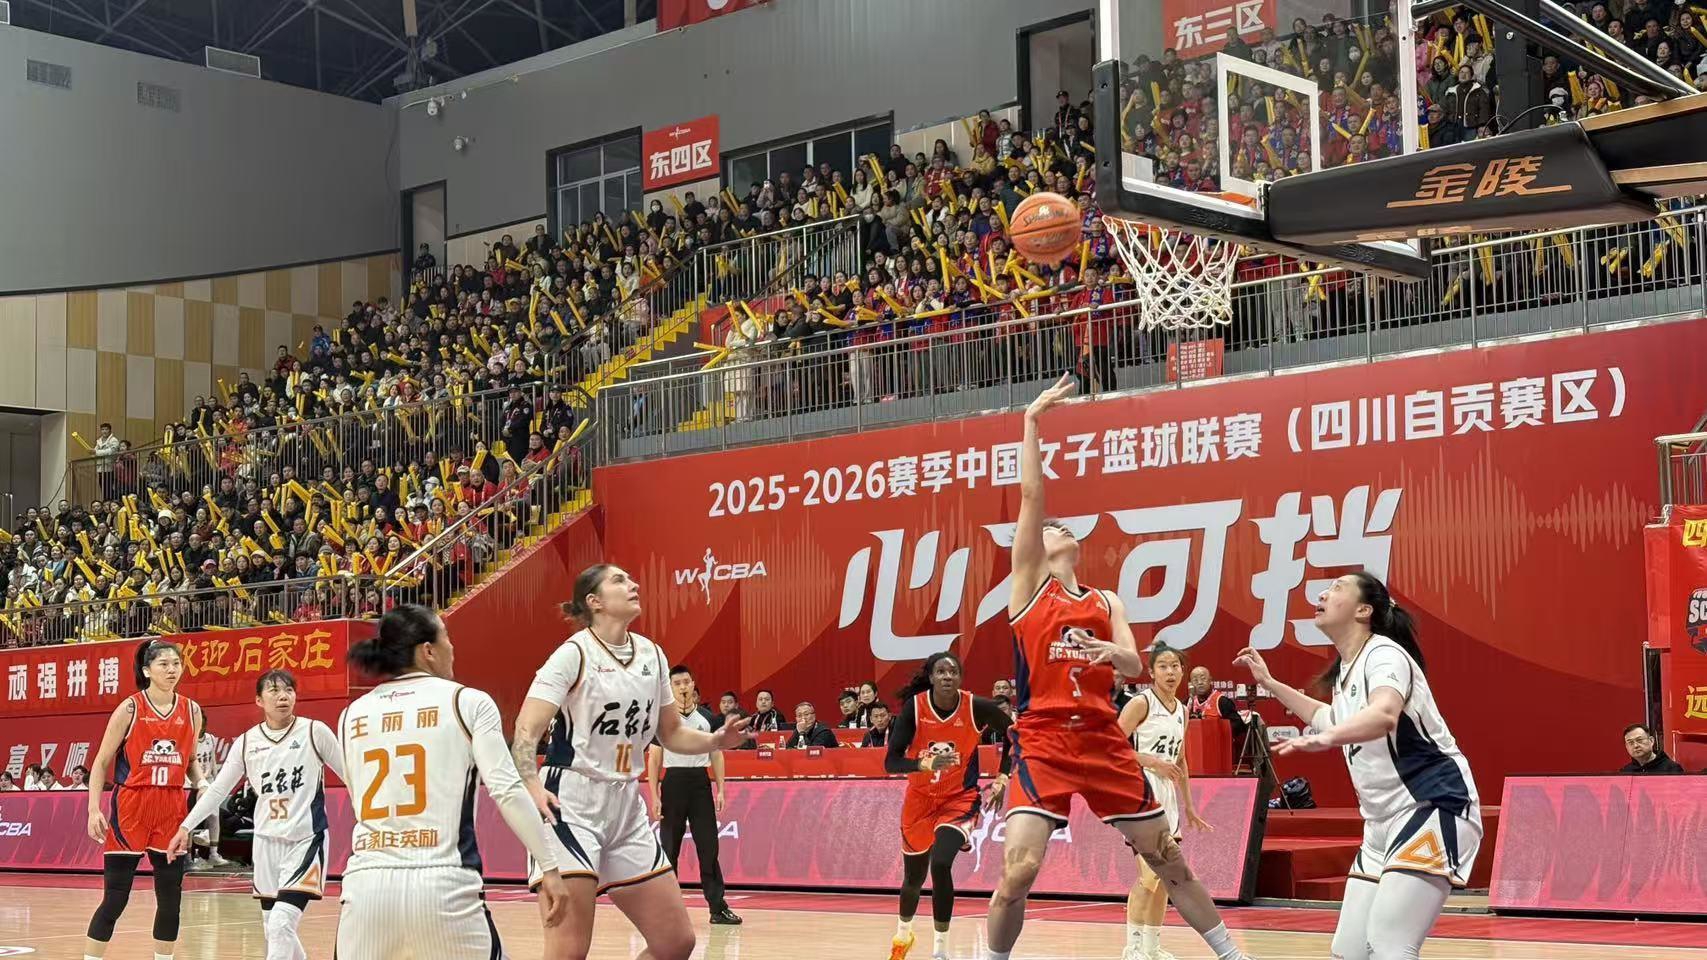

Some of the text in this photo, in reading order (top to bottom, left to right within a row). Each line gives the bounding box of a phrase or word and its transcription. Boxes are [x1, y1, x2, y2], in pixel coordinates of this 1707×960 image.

[1174, 0, 1265, 50] 东三区
[649, 139, 712, 180] 东四区
[1387, 156, 1572, 208] 金陵
[675, 561, 767, 585] WCBA
[176, 628, 334, 677] 欢迎石家庄
[8, 656, 119, 700] 顽强拼搏
[1069, 667, 1083, 697] 5
[351, 706, 439, 740] 王丽丽
[151, 766, 168, 786] 10
[361, 743, 427, 821] 23
[269, 797, 288, 820] 55
